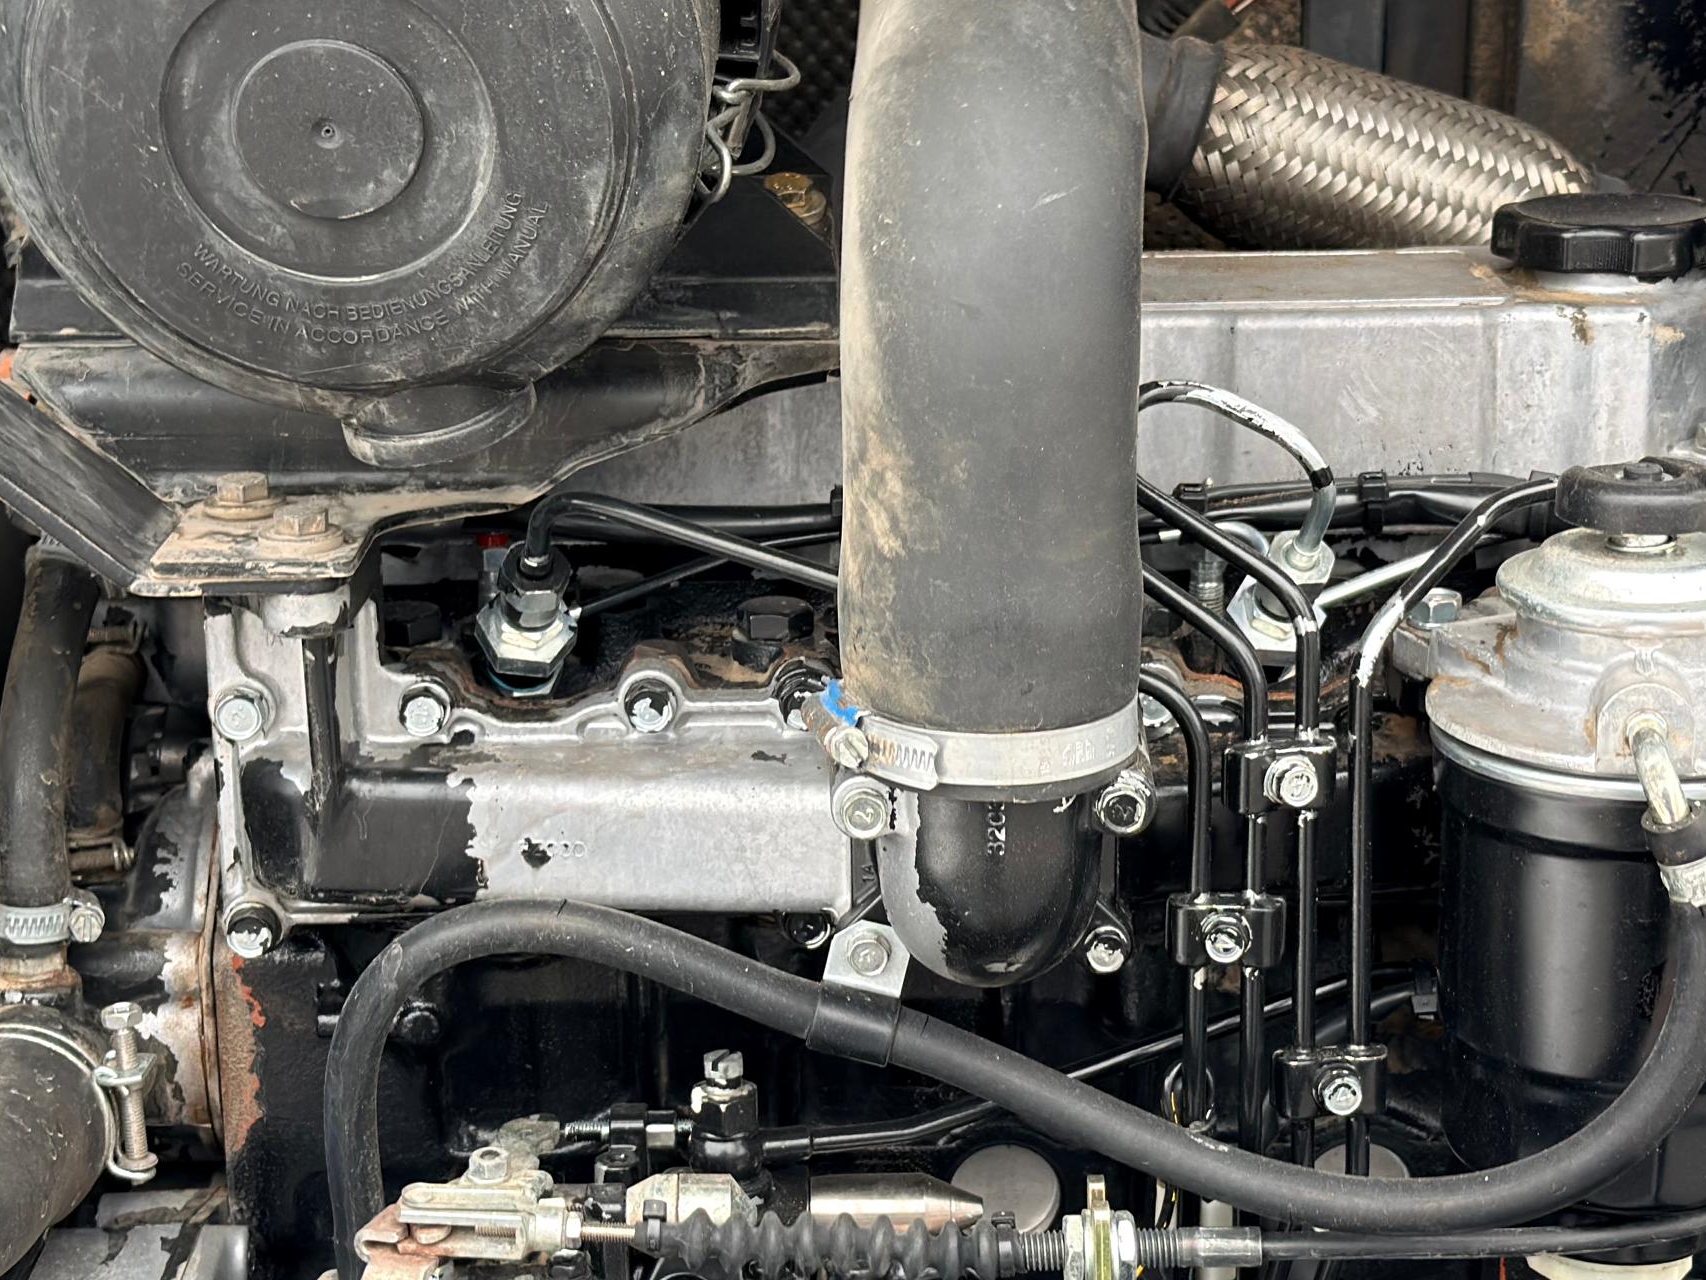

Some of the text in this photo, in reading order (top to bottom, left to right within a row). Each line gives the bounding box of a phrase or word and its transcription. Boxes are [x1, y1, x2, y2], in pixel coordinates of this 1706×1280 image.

[176, 199, 550, 346] SERVICE IN ACCORDANCE WITH MANUAL
[192, 190, 527, 322] WARTUNG NACH BEDIENUNGSANLEITUNG
